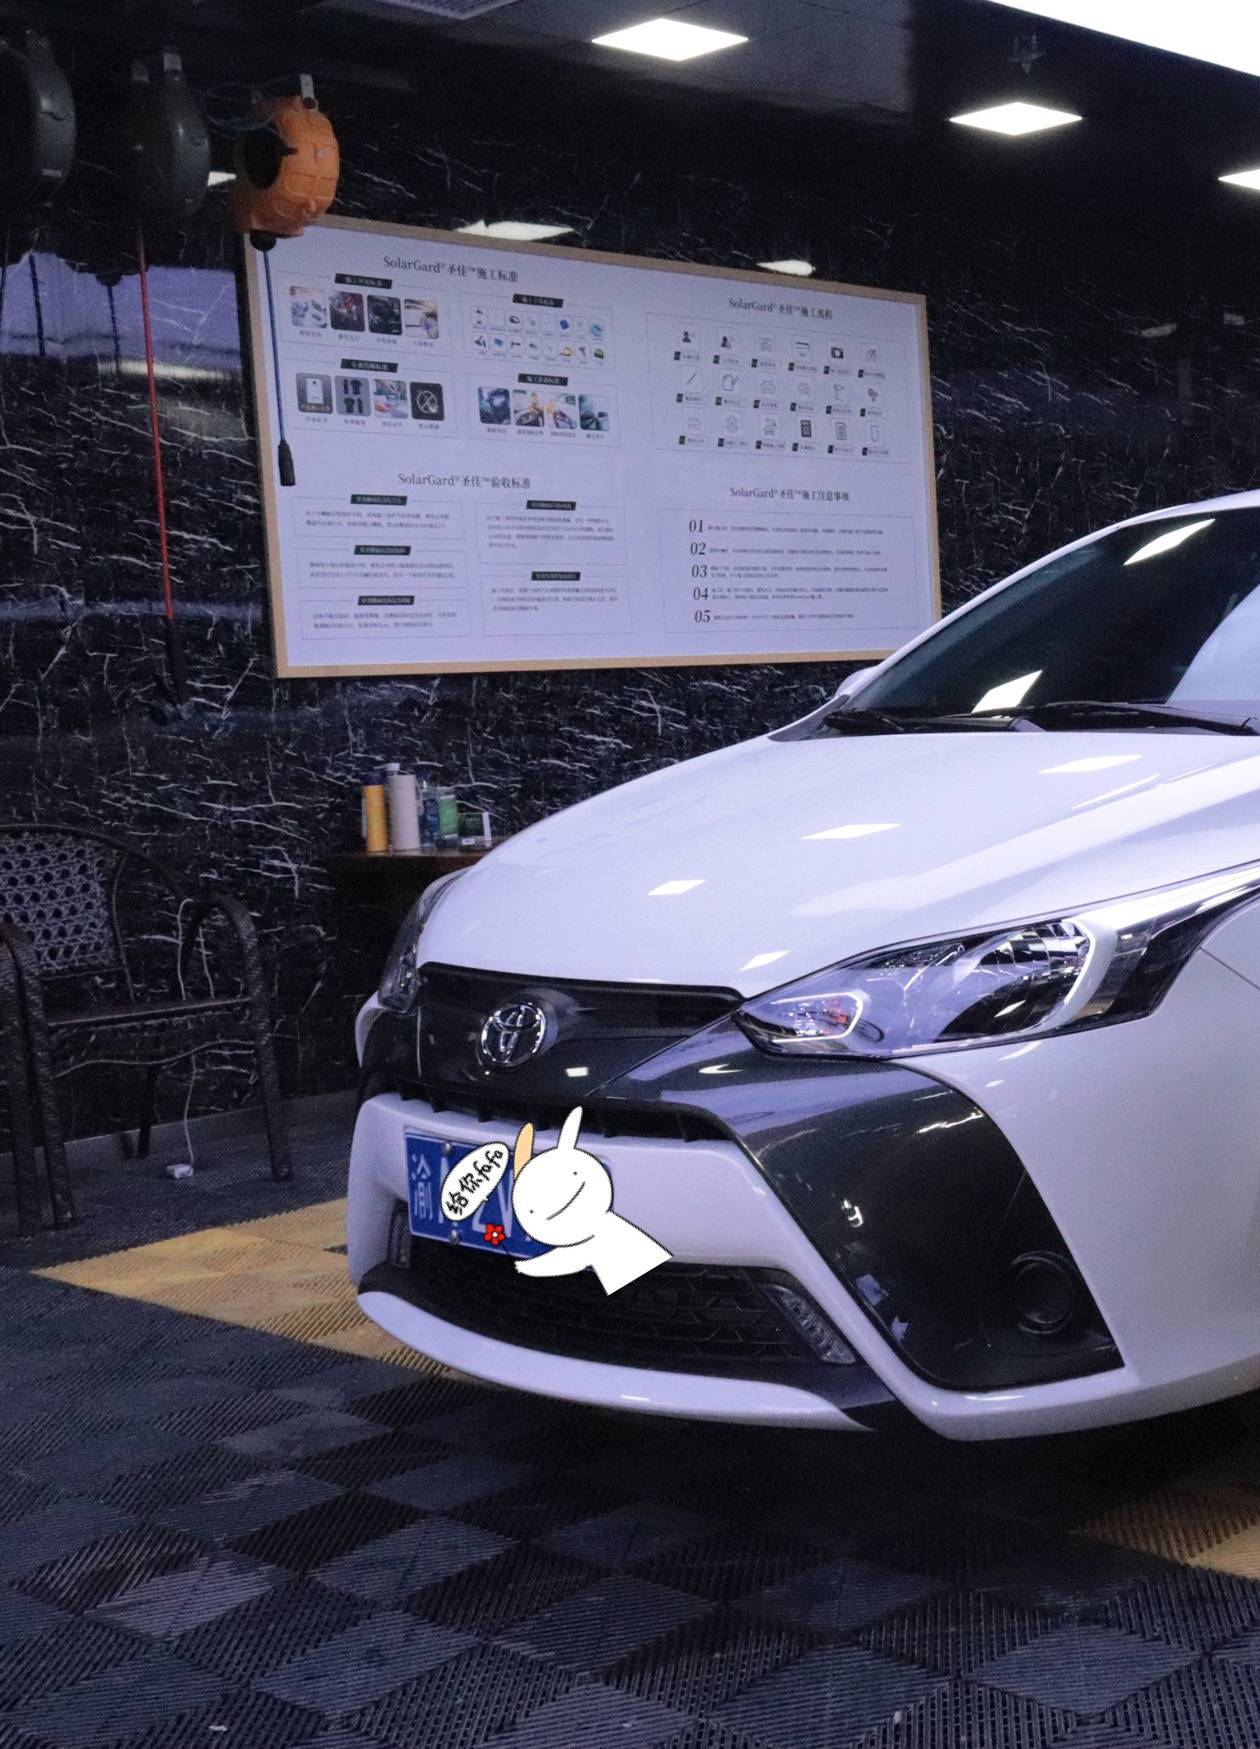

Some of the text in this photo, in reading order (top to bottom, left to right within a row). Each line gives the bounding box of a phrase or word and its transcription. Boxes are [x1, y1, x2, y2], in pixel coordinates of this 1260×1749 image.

[688, 519, 703, 533] 01
[690, 542, 706, 556] 02
[691, 564, 707, 578] 03
[693, 587, 708, 601] 04
[694, 609, 711, 623] 05
